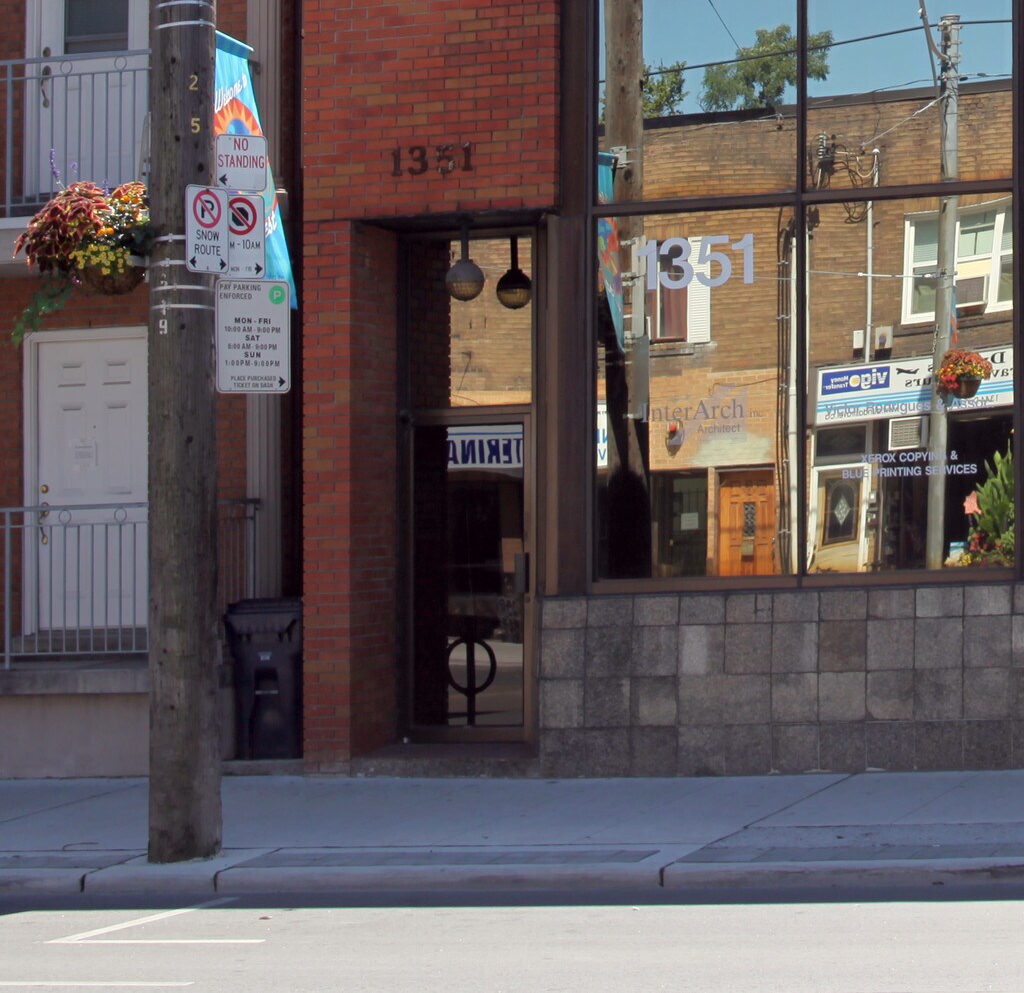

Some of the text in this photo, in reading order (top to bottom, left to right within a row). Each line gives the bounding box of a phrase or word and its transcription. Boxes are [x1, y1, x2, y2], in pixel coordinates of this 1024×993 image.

[233, 138, 249, 152] NO
[217, 154, 265, 169] STANDING
[390, 142, 475, 178] 1351
[196, 230, 220, 241] SNOW
[194, 244, 221, 257] ROUTE
[242, 239, 261, 250] 10AM
[637, 232, 755, 291] 1351
[219, 283, 261, 291] PAY PARKING
[219, 292, 252, 300] ENFORCED
[641, 398, 745, 423] InterArch
[698, 424, 741, 434] Architect
[861, 453, 896, 463] XEROX
[950, 450, 958, 460] &
[842, 463, 978, 479] BLUE PRINTING SERVICES
